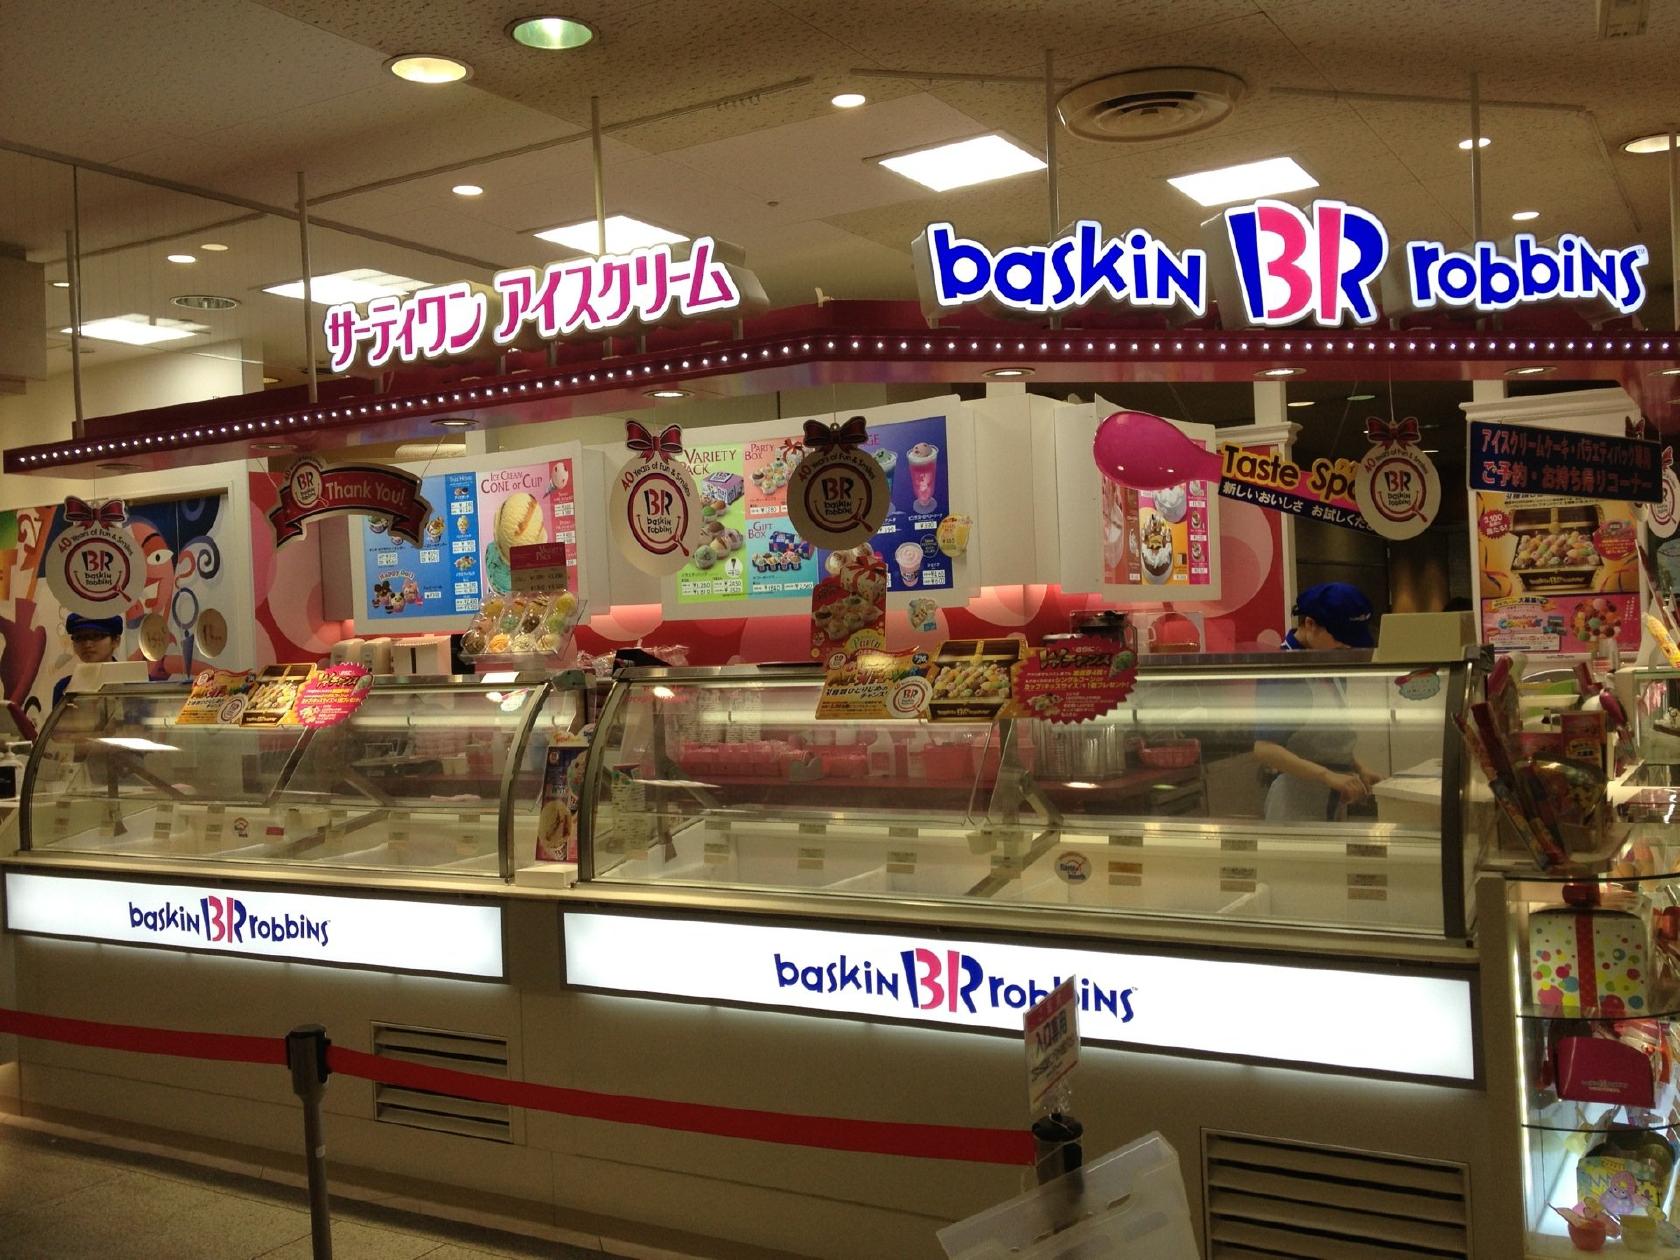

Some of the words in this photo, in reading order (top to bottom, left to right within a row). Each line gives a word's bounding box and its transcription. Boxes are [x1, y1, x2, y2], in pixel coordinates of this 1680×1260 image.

[931, 222, 1204, 312] baskin
[1226, 204, 1387, 323] BR
[1408, 238, 1644, 311] robbins
[327, 288, 483, 370] サーティワン
[498, 243, 736, 340] アイスクリーム
[684, 449, 737, 464] VARIETY
[744, 451, 763, 464] BOX
[751, 443, 774, 456] PARTY
[798, 464, 812, 482] 40
[1224, 444, 1299, 487] Taste
[1364, 457, 1376, 474] 40
[296, 471, 315, 491] BR
[480, 478, 511, 494] CONE
[522, 473, 543, 489] CUP
[622, 471, 635, 492] 40
[633, 463, 651, 477] Years
[821, 477, 854, 500] BR
[1383, 470, 1411, 492] BR
[325, 478, 374, 500] Thank
[375, 481, 407, 506] You!
[644, 488, 673, 516] BR
[1222, 480, 1304, 514] 新しいおいしさ
[1312, 504, 1375, 533] お試しくだ
[647, 517, 672, 526] baskin
[753, 521, 773, 532] GIFT
[57, 536, 73, 553] 40
[748, 529, 766, 540] BOX
[81, 549, 114, 572] BR
[129, 900, 201, 936] baskin
[201, 895, 244, 944] BR
[249, 914, 331, 947] robbins
[773, 953, 900, 1000] baskin
[900, 947, 985, 1014] BR
[988, 975, 1136, 1024] robins
